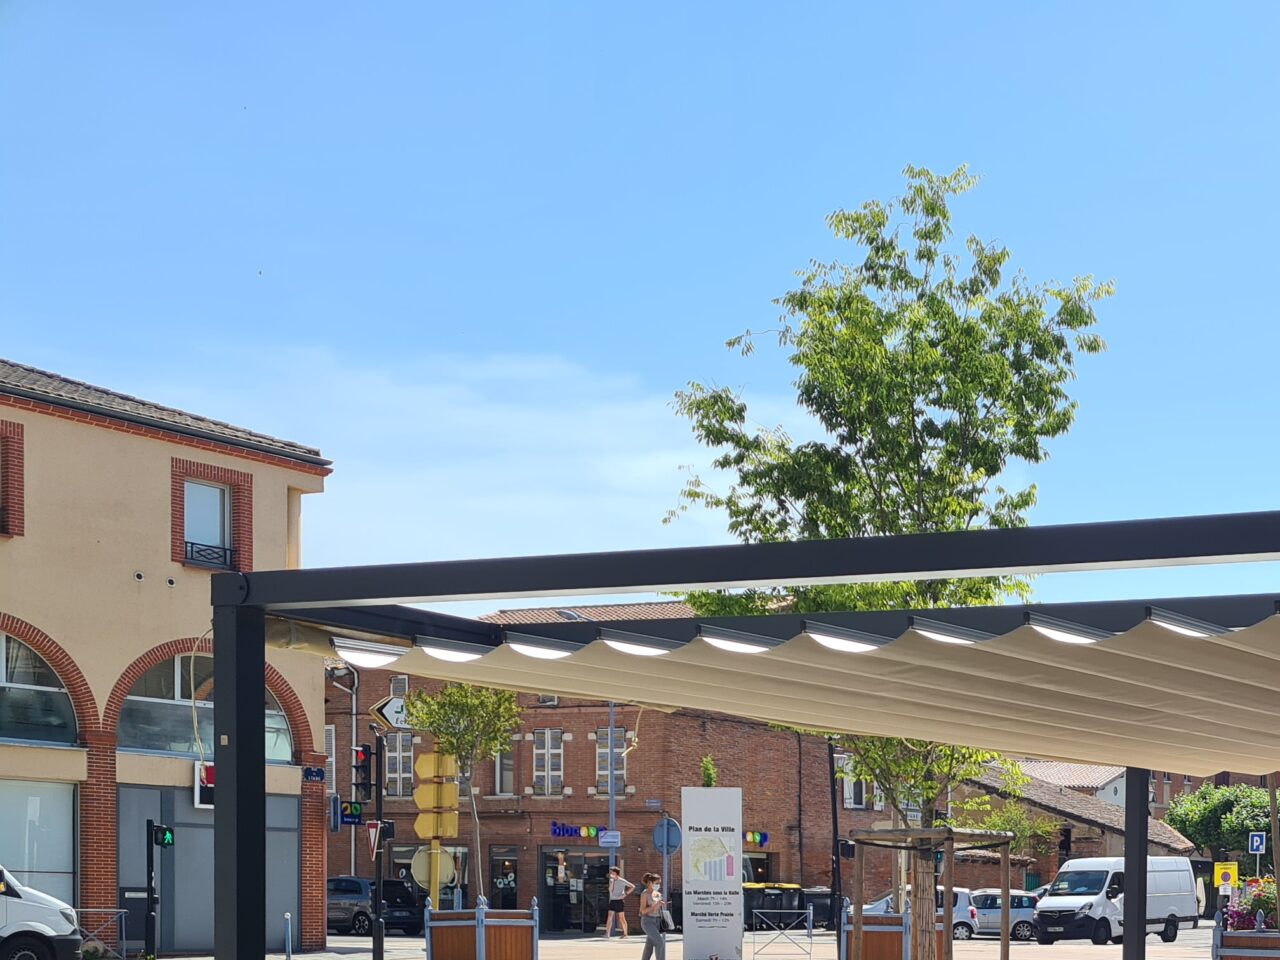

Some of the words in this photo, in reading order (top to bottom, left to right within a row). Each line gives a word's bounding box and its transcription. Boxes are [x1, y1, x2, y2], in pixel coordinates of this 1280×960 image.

[551, 821, 608, 838] biocoo
[688, 825, 703, 833] Plan
[703, 825, 712, 833] de
[713, 825, 720, 833] la
[720, 825, 736, 833] Ville
[1253, 836, 1261, 849] P
